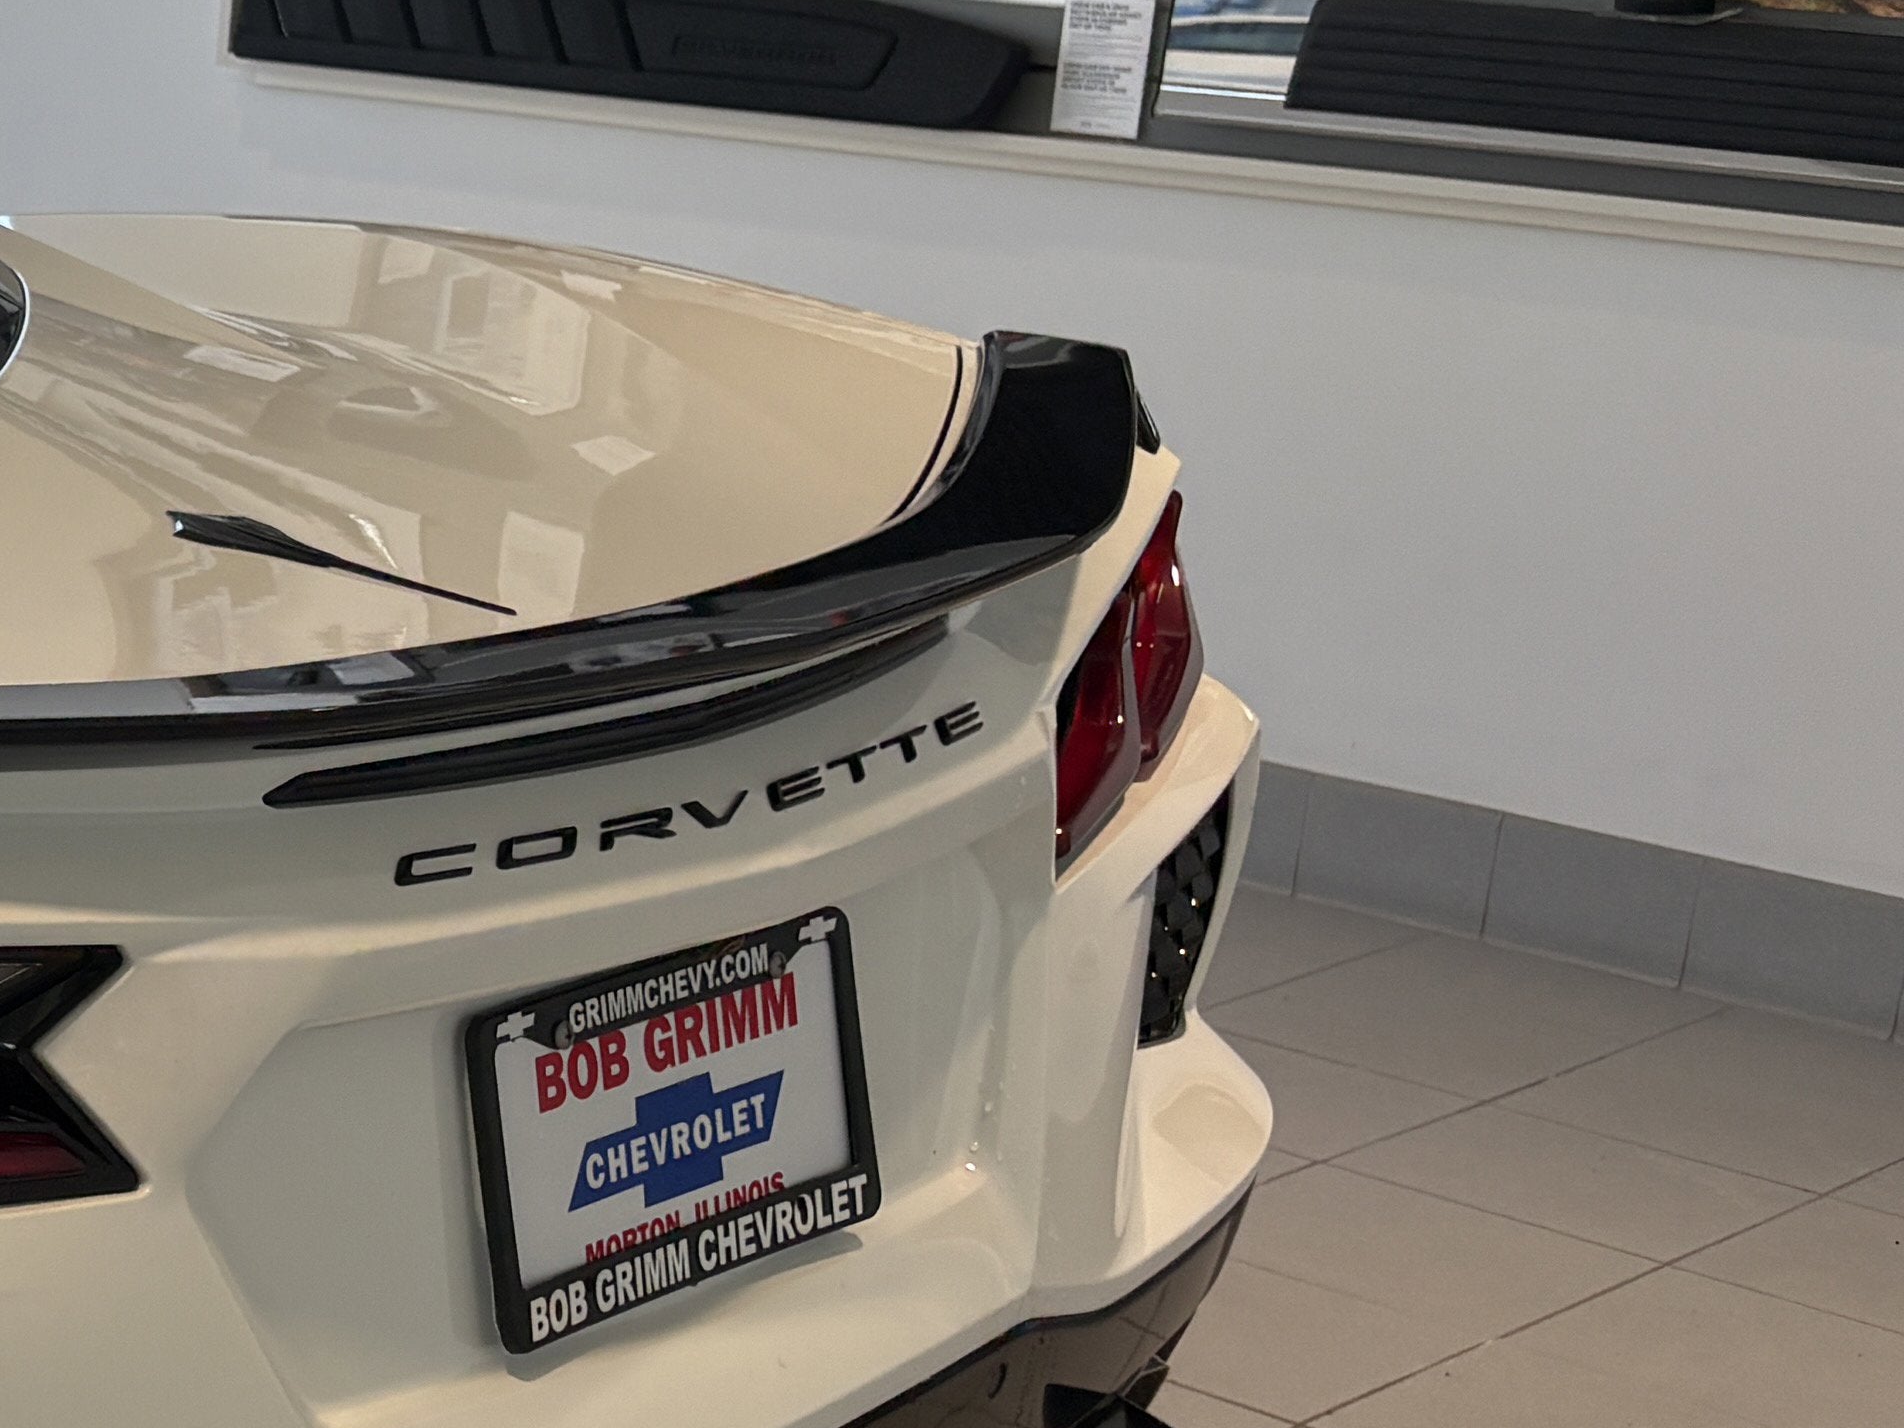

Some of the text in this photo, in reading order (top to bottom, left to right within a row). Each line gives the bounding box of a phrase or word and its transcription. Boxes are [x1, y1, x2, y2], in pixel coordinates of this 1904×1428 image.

[393, 700, 985, 887] CORVETTE
[534, 972, 798, 1114] BOB GRIMM
[568, 941, 770, 1034] GRIMMCHEVY.COM
[585, 1093, 766, 1190] CHEVROLET
[694, 1171, 786, 1223] ILLINOIS
[530, 1174, 869, 1343] BOB GRIMM CHEVROLET
